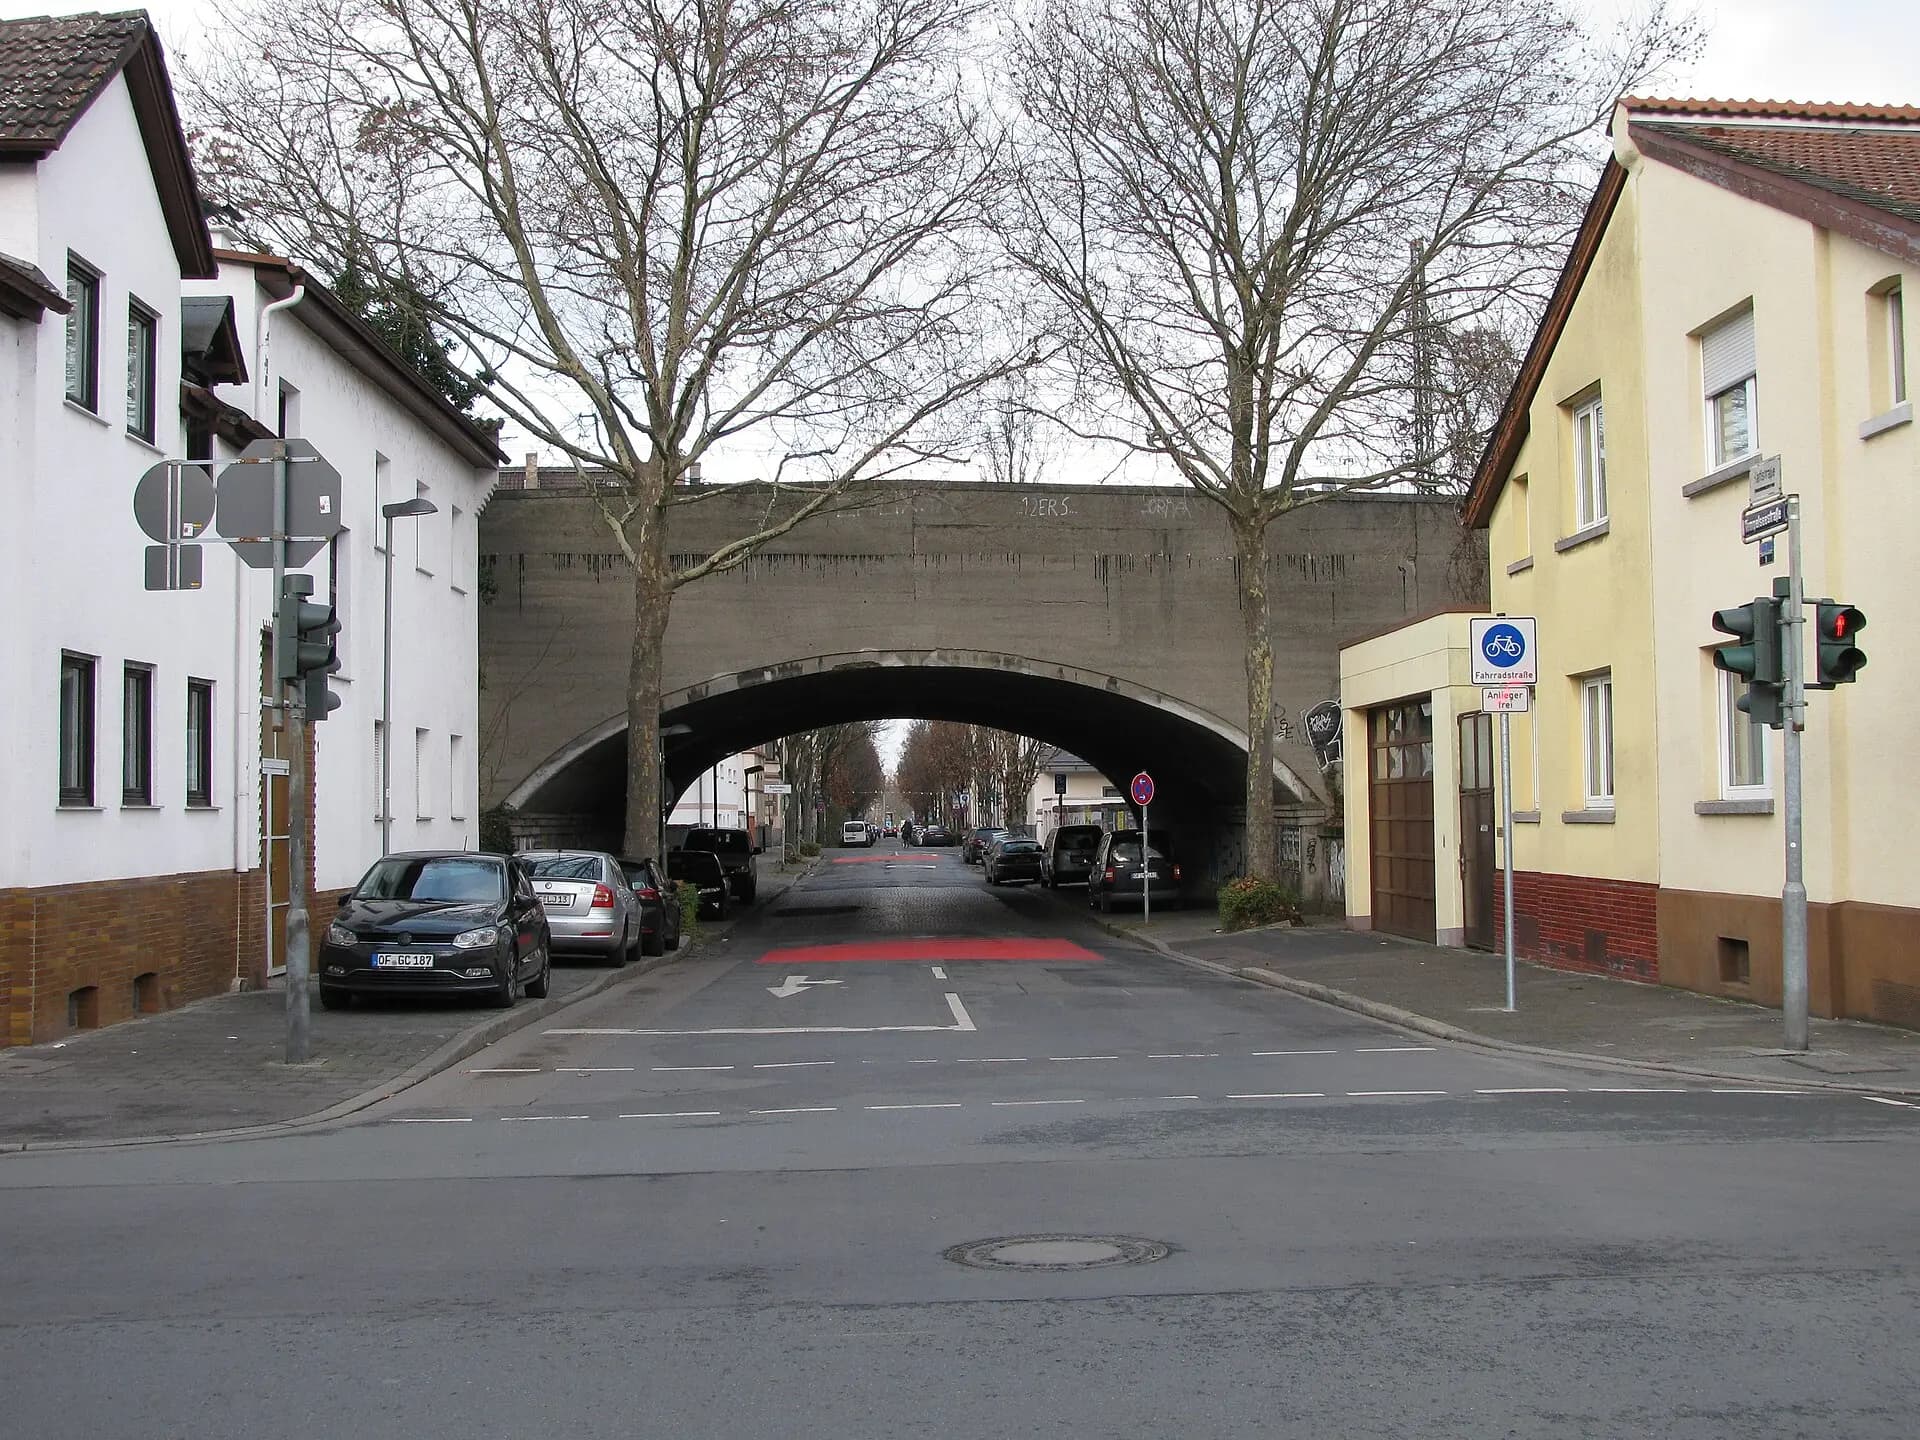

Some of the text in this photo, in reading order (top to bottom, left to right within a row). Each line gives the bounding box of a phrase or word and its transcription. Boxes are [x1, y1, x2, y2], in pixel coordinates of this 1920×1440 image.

[1475, 670, 1534, 679] Fahrradstraße
[1487, 691, 1524, 700] Anlieger
[378, 955, 432, 966] OF GC 187
